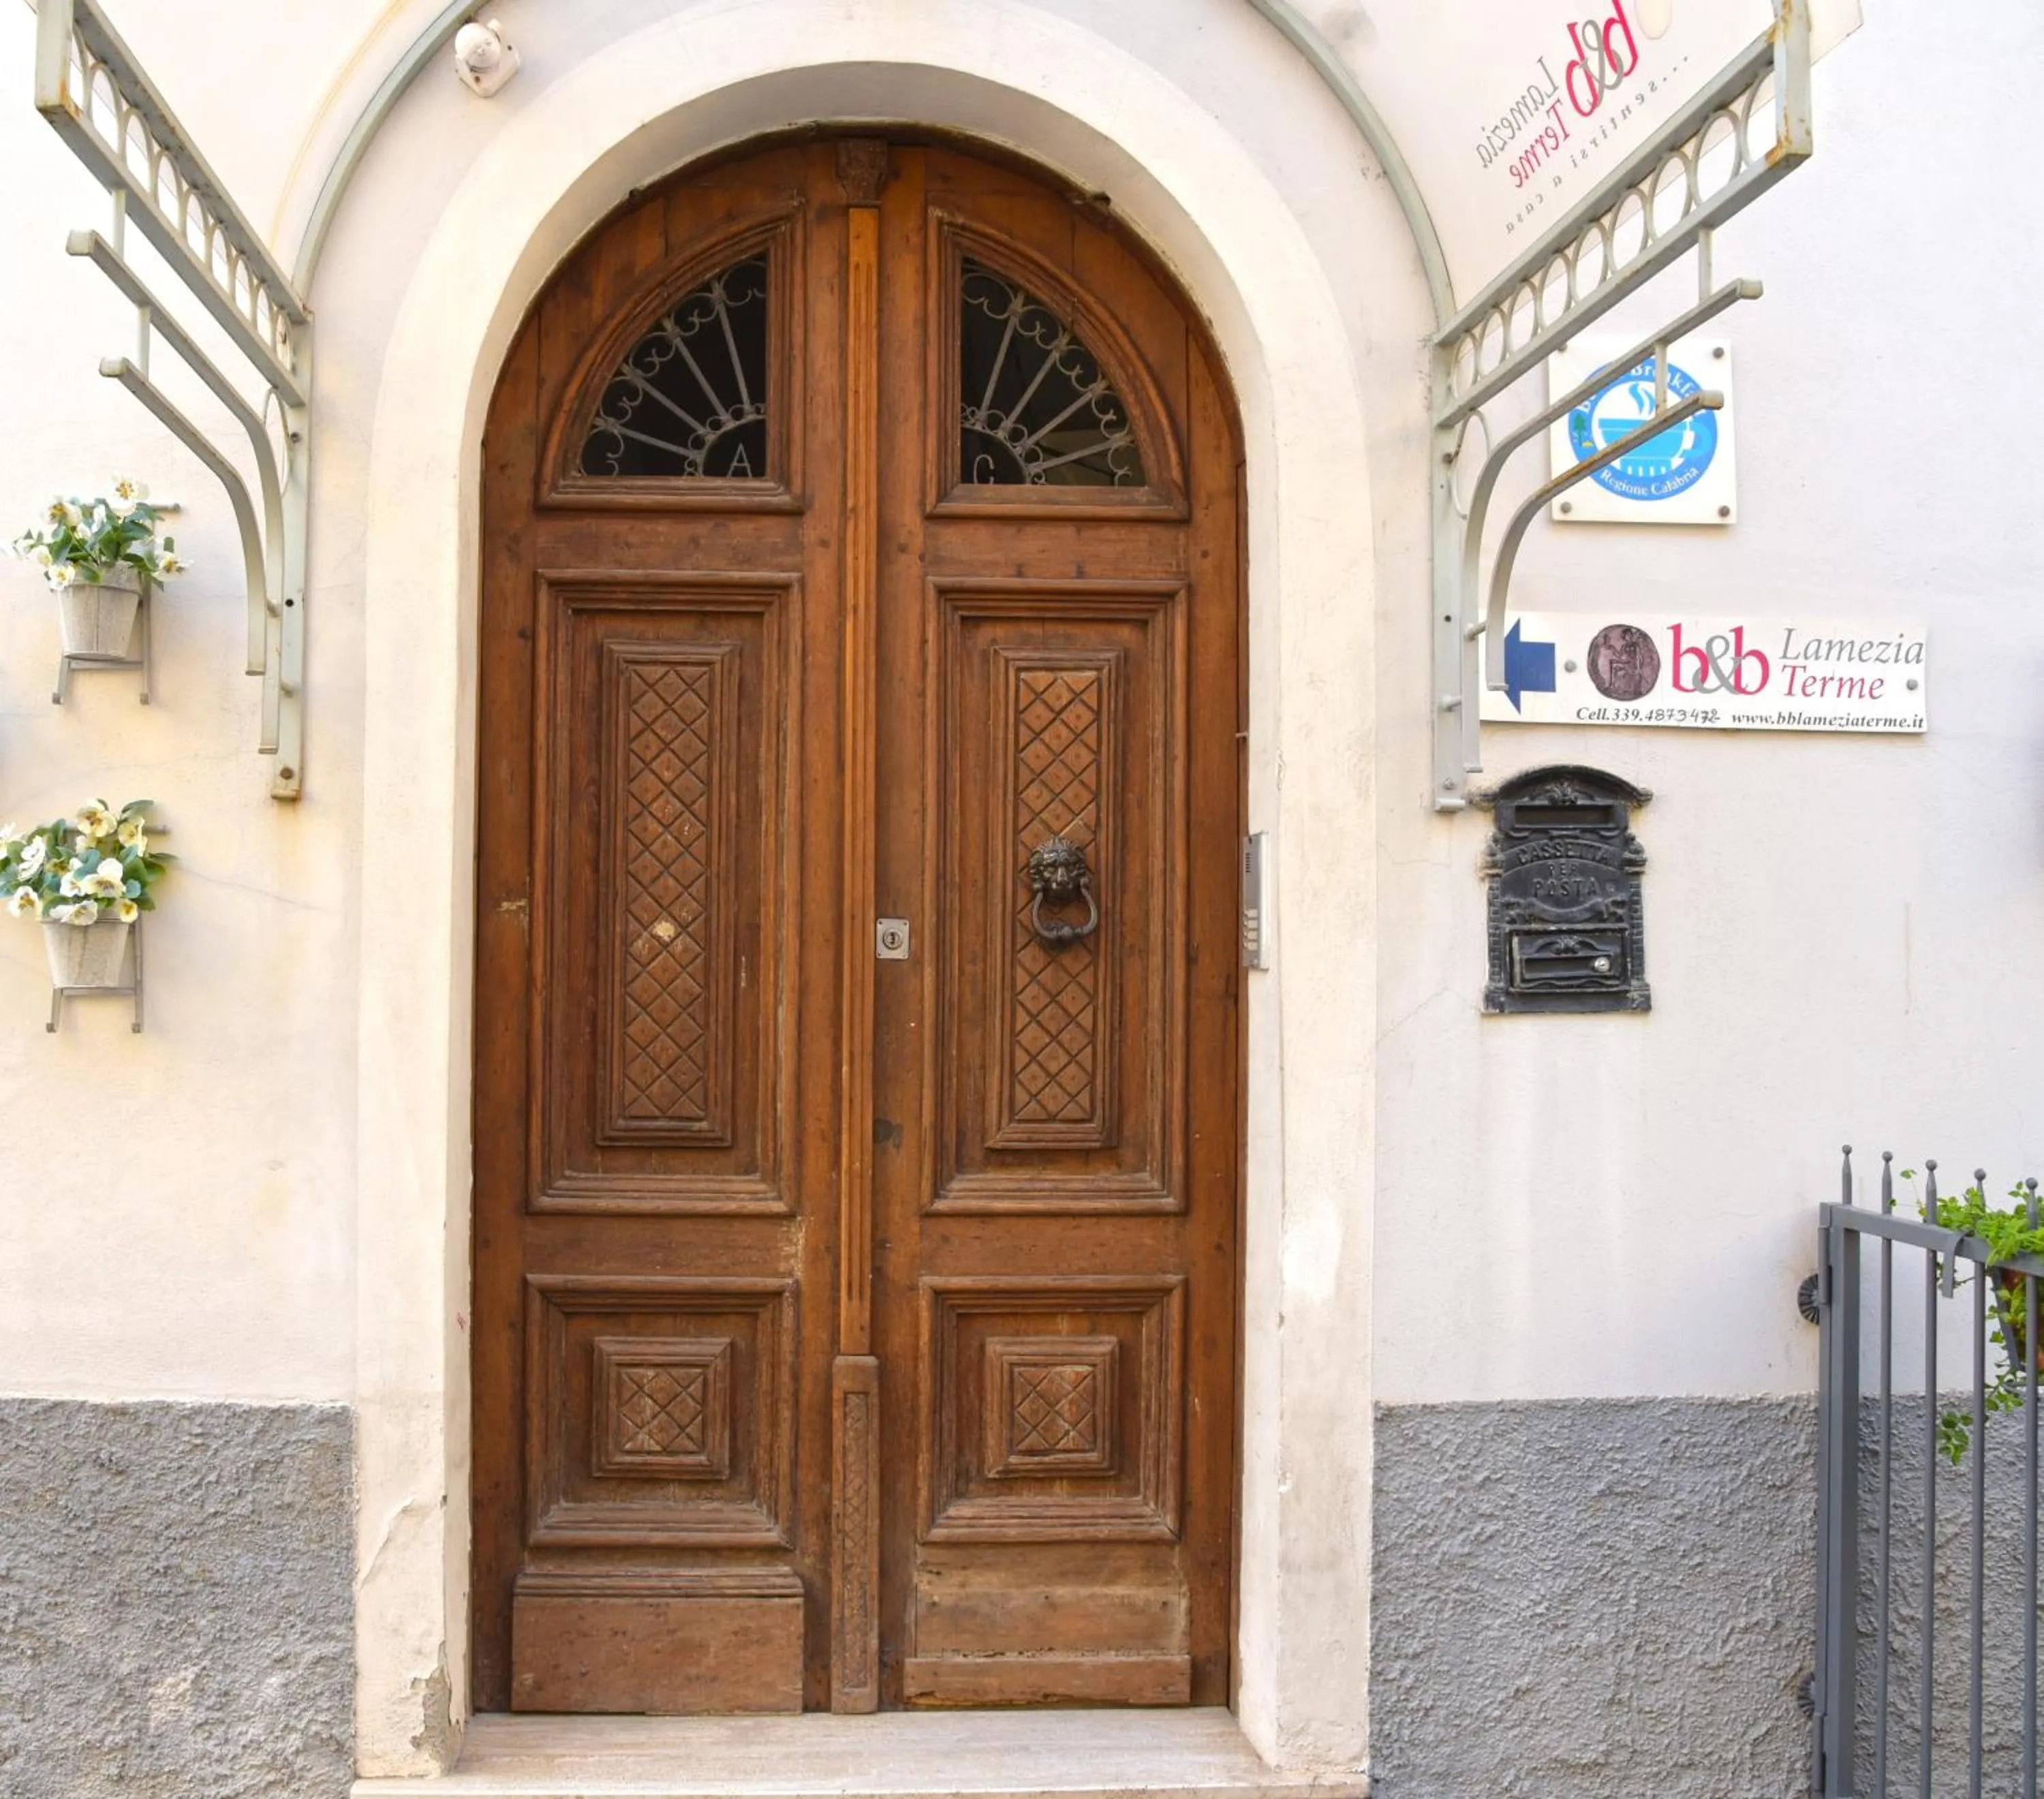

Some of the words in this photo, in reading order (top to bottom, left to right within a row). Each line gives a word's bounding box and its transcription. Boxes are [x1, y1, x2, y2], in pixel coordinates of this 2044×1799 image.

[726, 442, 753, 478] A
[1600, 469, 1649, 496] Regione
[1650, 467, 1699, 495] Calabria
[1667, 622, 1770, 696] b&b
[1778, 627, 1925, 665] Lamezia
[1781, 664, 1885, 700] Terme
[1731, 711, 1925, 728] www.bblameziaterme.it
[1532, 876, 1603, 897] POSTA
